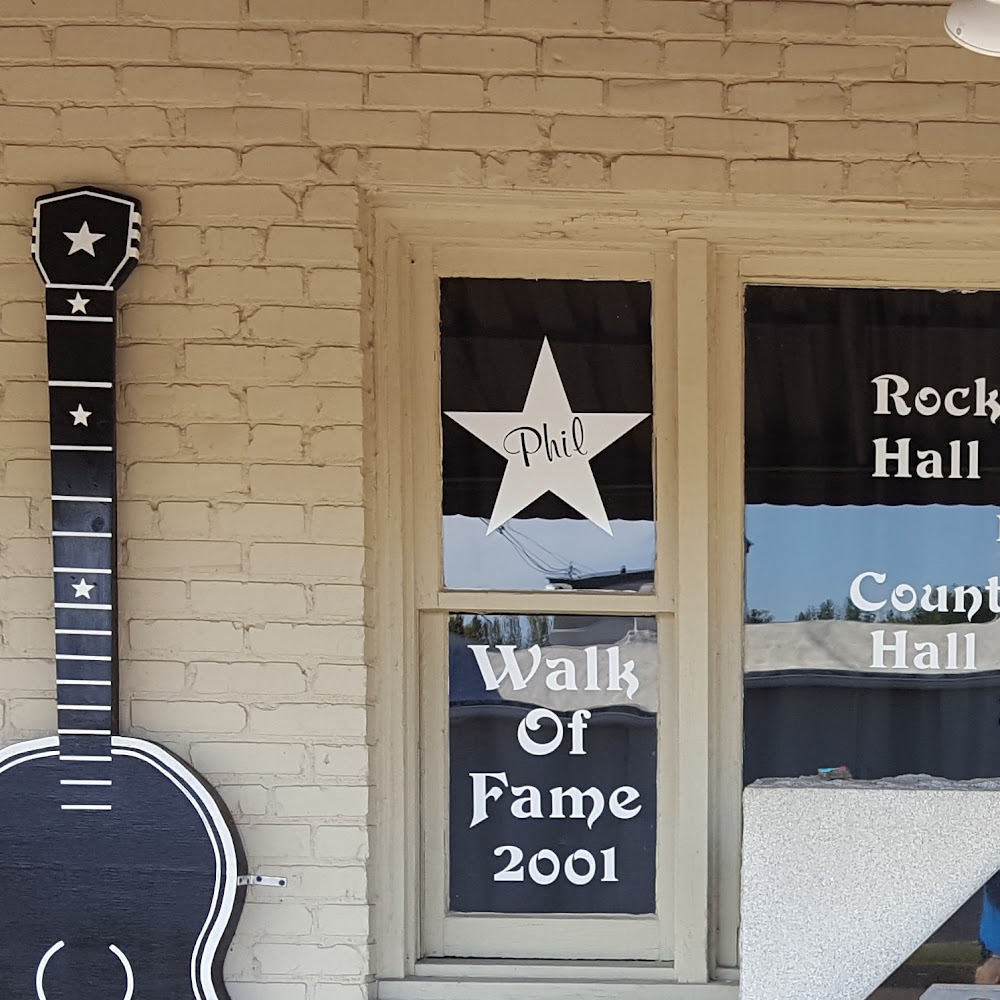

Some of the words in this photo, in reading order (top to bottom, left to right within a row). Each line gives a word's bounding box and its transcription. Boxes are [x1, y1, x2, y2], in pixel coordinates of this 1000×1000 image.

[503, 416, 588, 468] Phil
[872, 437, 981, 480] Hall
[467, 644, 640, 700] Walk
[869, 629, 978, 672] Hall
[517, 708, 592, 756] Of
[469, 772, 643, 829] Fame
[493, 845, 619, 886] 2001
